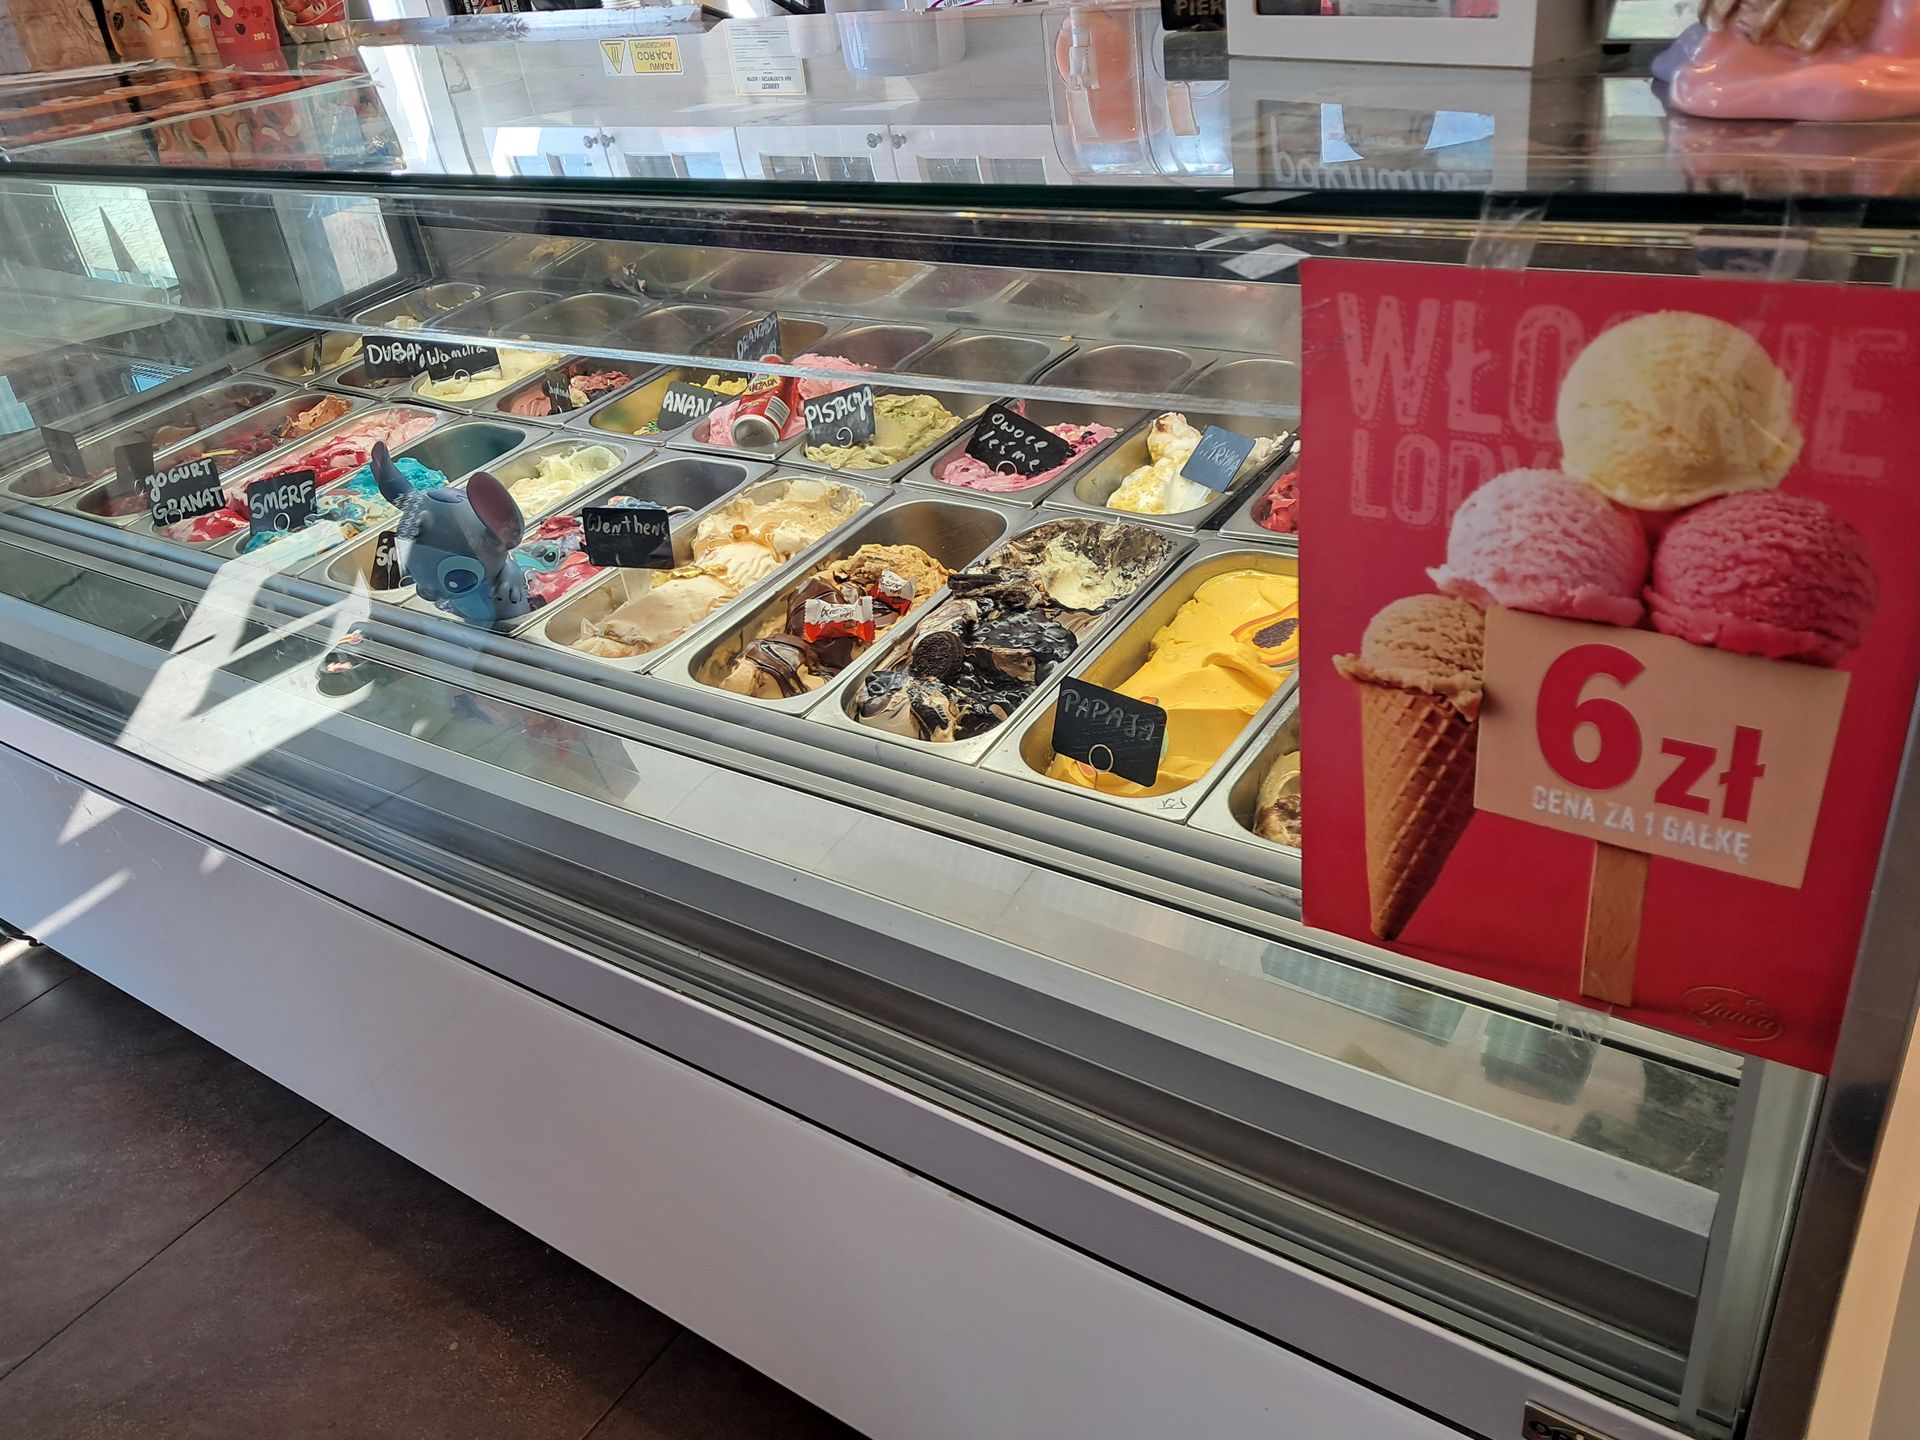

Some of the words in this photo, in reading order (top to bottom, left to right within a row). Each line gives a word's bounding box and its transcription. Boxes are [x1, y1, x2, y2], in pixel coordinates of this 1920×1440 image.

[145, 458, 212, 501] JOGURT
[152, 486, 226, 521] GRANAT
[249, 479, 315, 520] SMERF
[1061, 688, 1156, 741] PAPAJA
[1536, 643, 1647, 790] 6
[1654, 725, 1767, 823] zł
[1531, 785, 1596, 823] CENA
[1604, 801, 1636, 833] ZA
[1645, 811, 1654, 836] 1
[1662, 815, 1751, 865] GAŁKĘ
